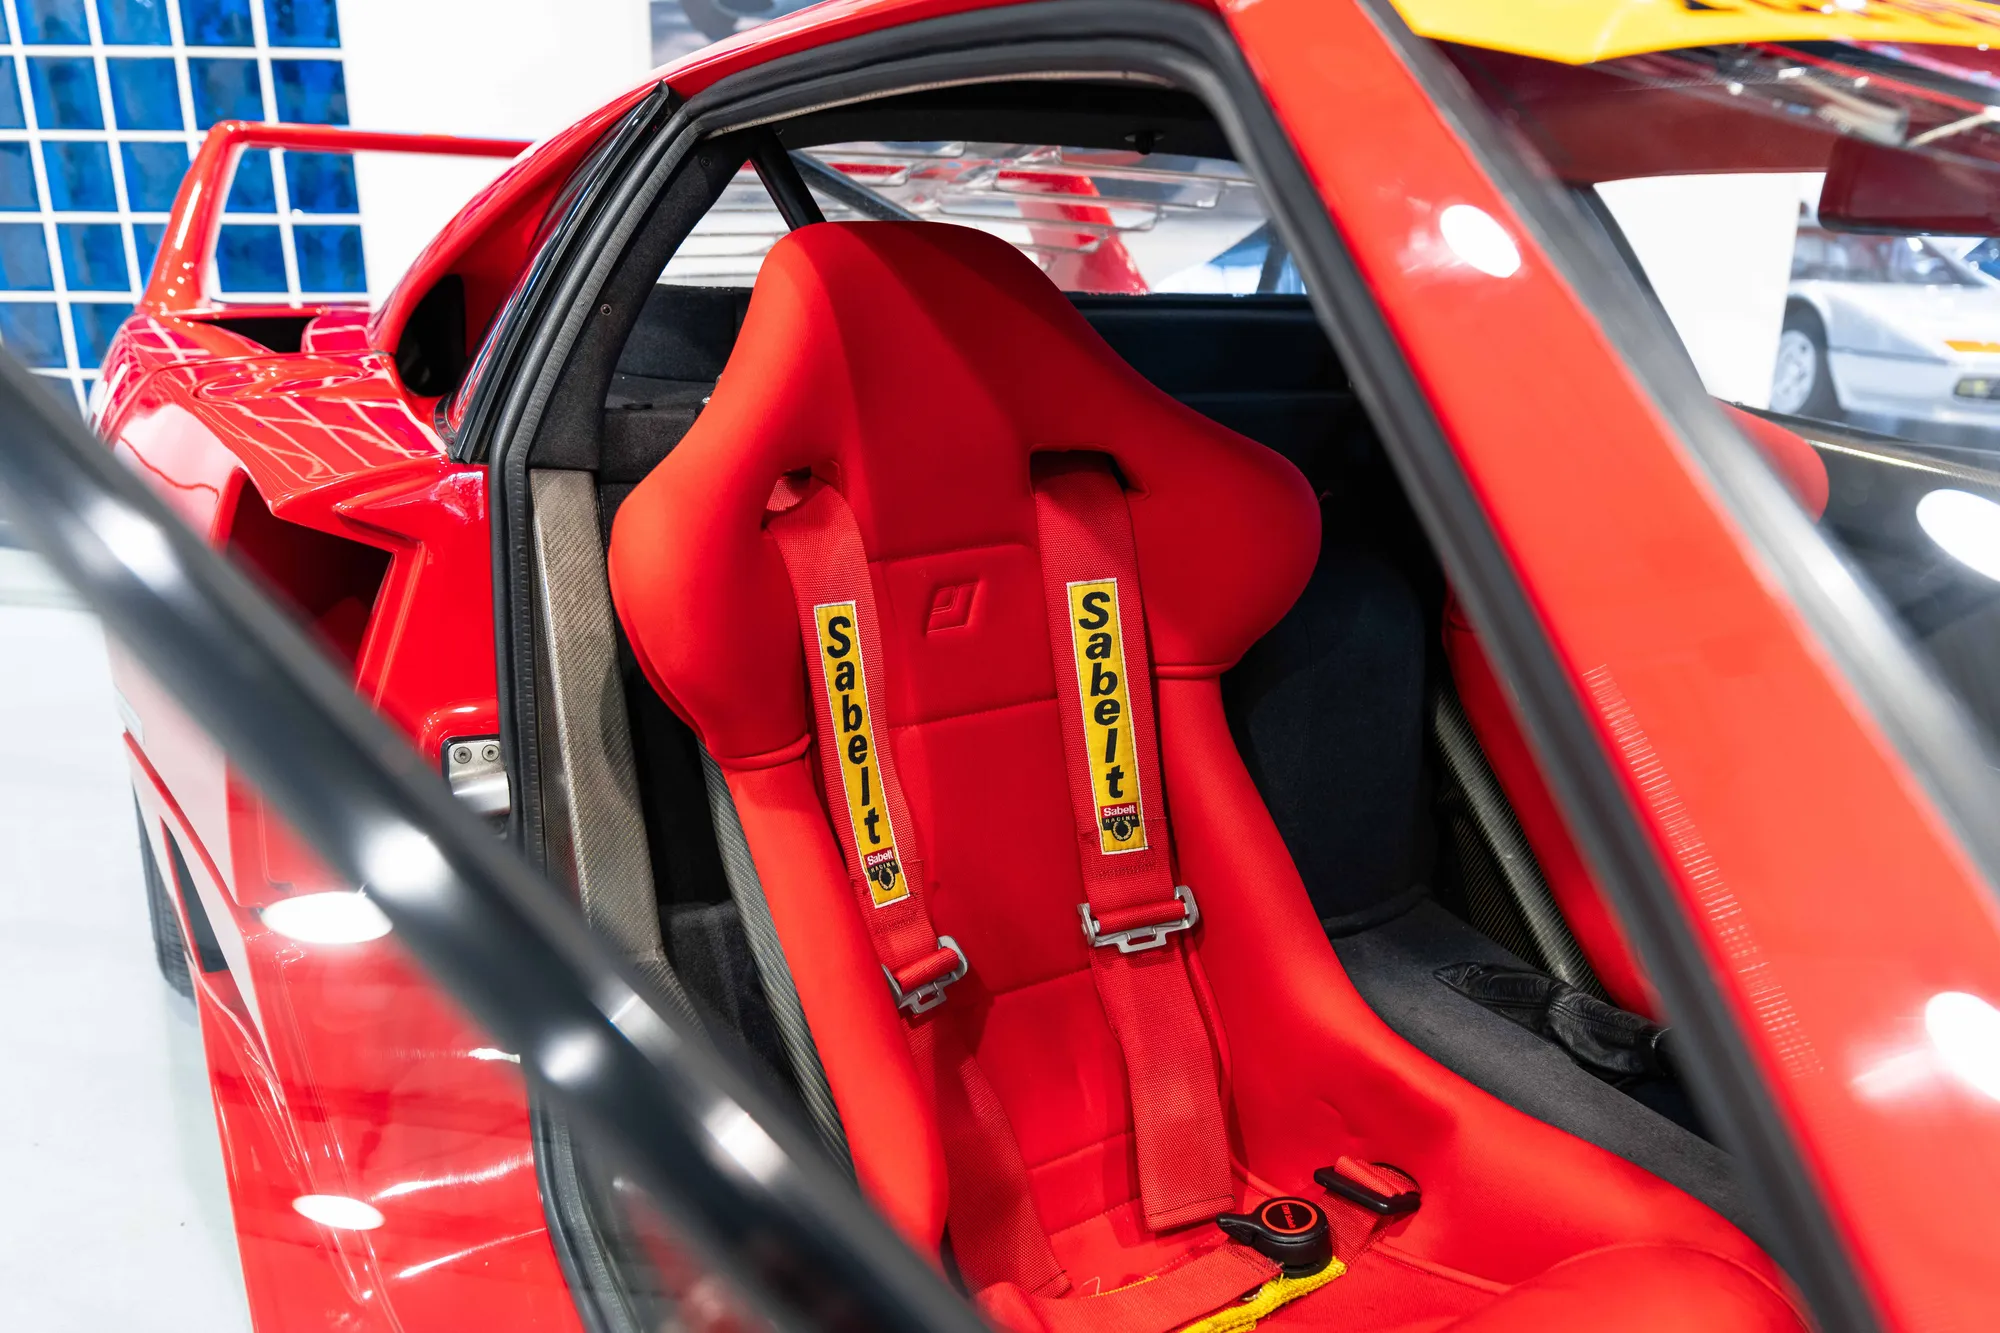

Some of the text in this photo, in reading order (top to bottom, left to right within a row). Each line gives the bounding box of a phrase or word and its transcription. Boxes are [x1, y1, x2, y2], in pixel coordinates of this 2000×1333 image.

[826, 615, 880, 845] Sabelt
[1078, 591, 1124, 799] Sabelt
[867, 849, 894, 865] Sabelt
[1103, 804, 1136, 817] Sabelt
